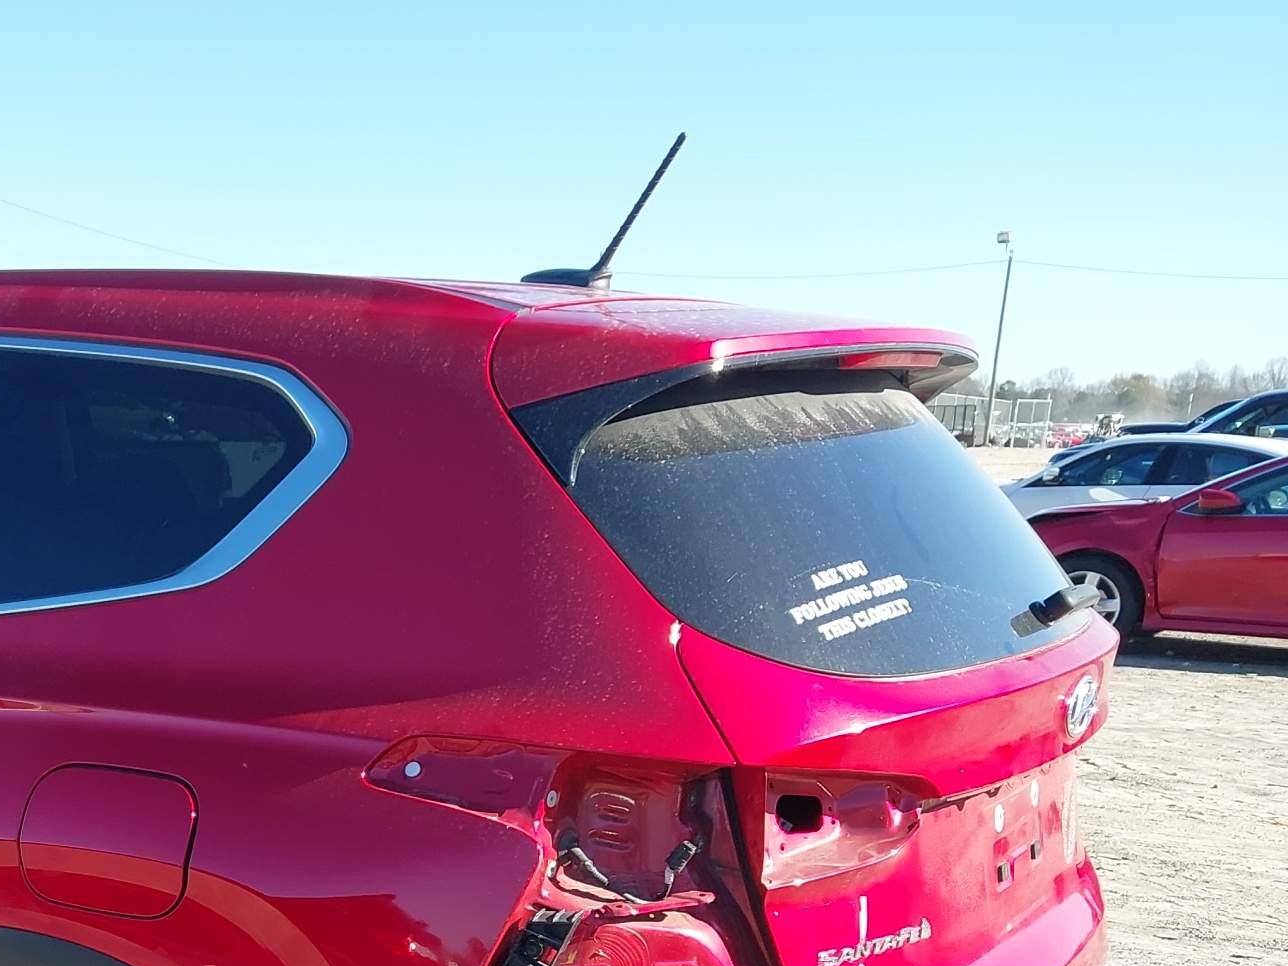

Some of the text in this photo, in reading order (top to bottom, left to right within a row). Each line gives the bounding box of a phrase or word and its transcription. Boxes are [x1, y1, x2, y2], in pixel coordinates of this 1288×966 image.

[811, 560, 868, 590] ARE YOU
[789, 584, 872, 624] FOLLOWING
[818, 616, 856, 640] THIS
